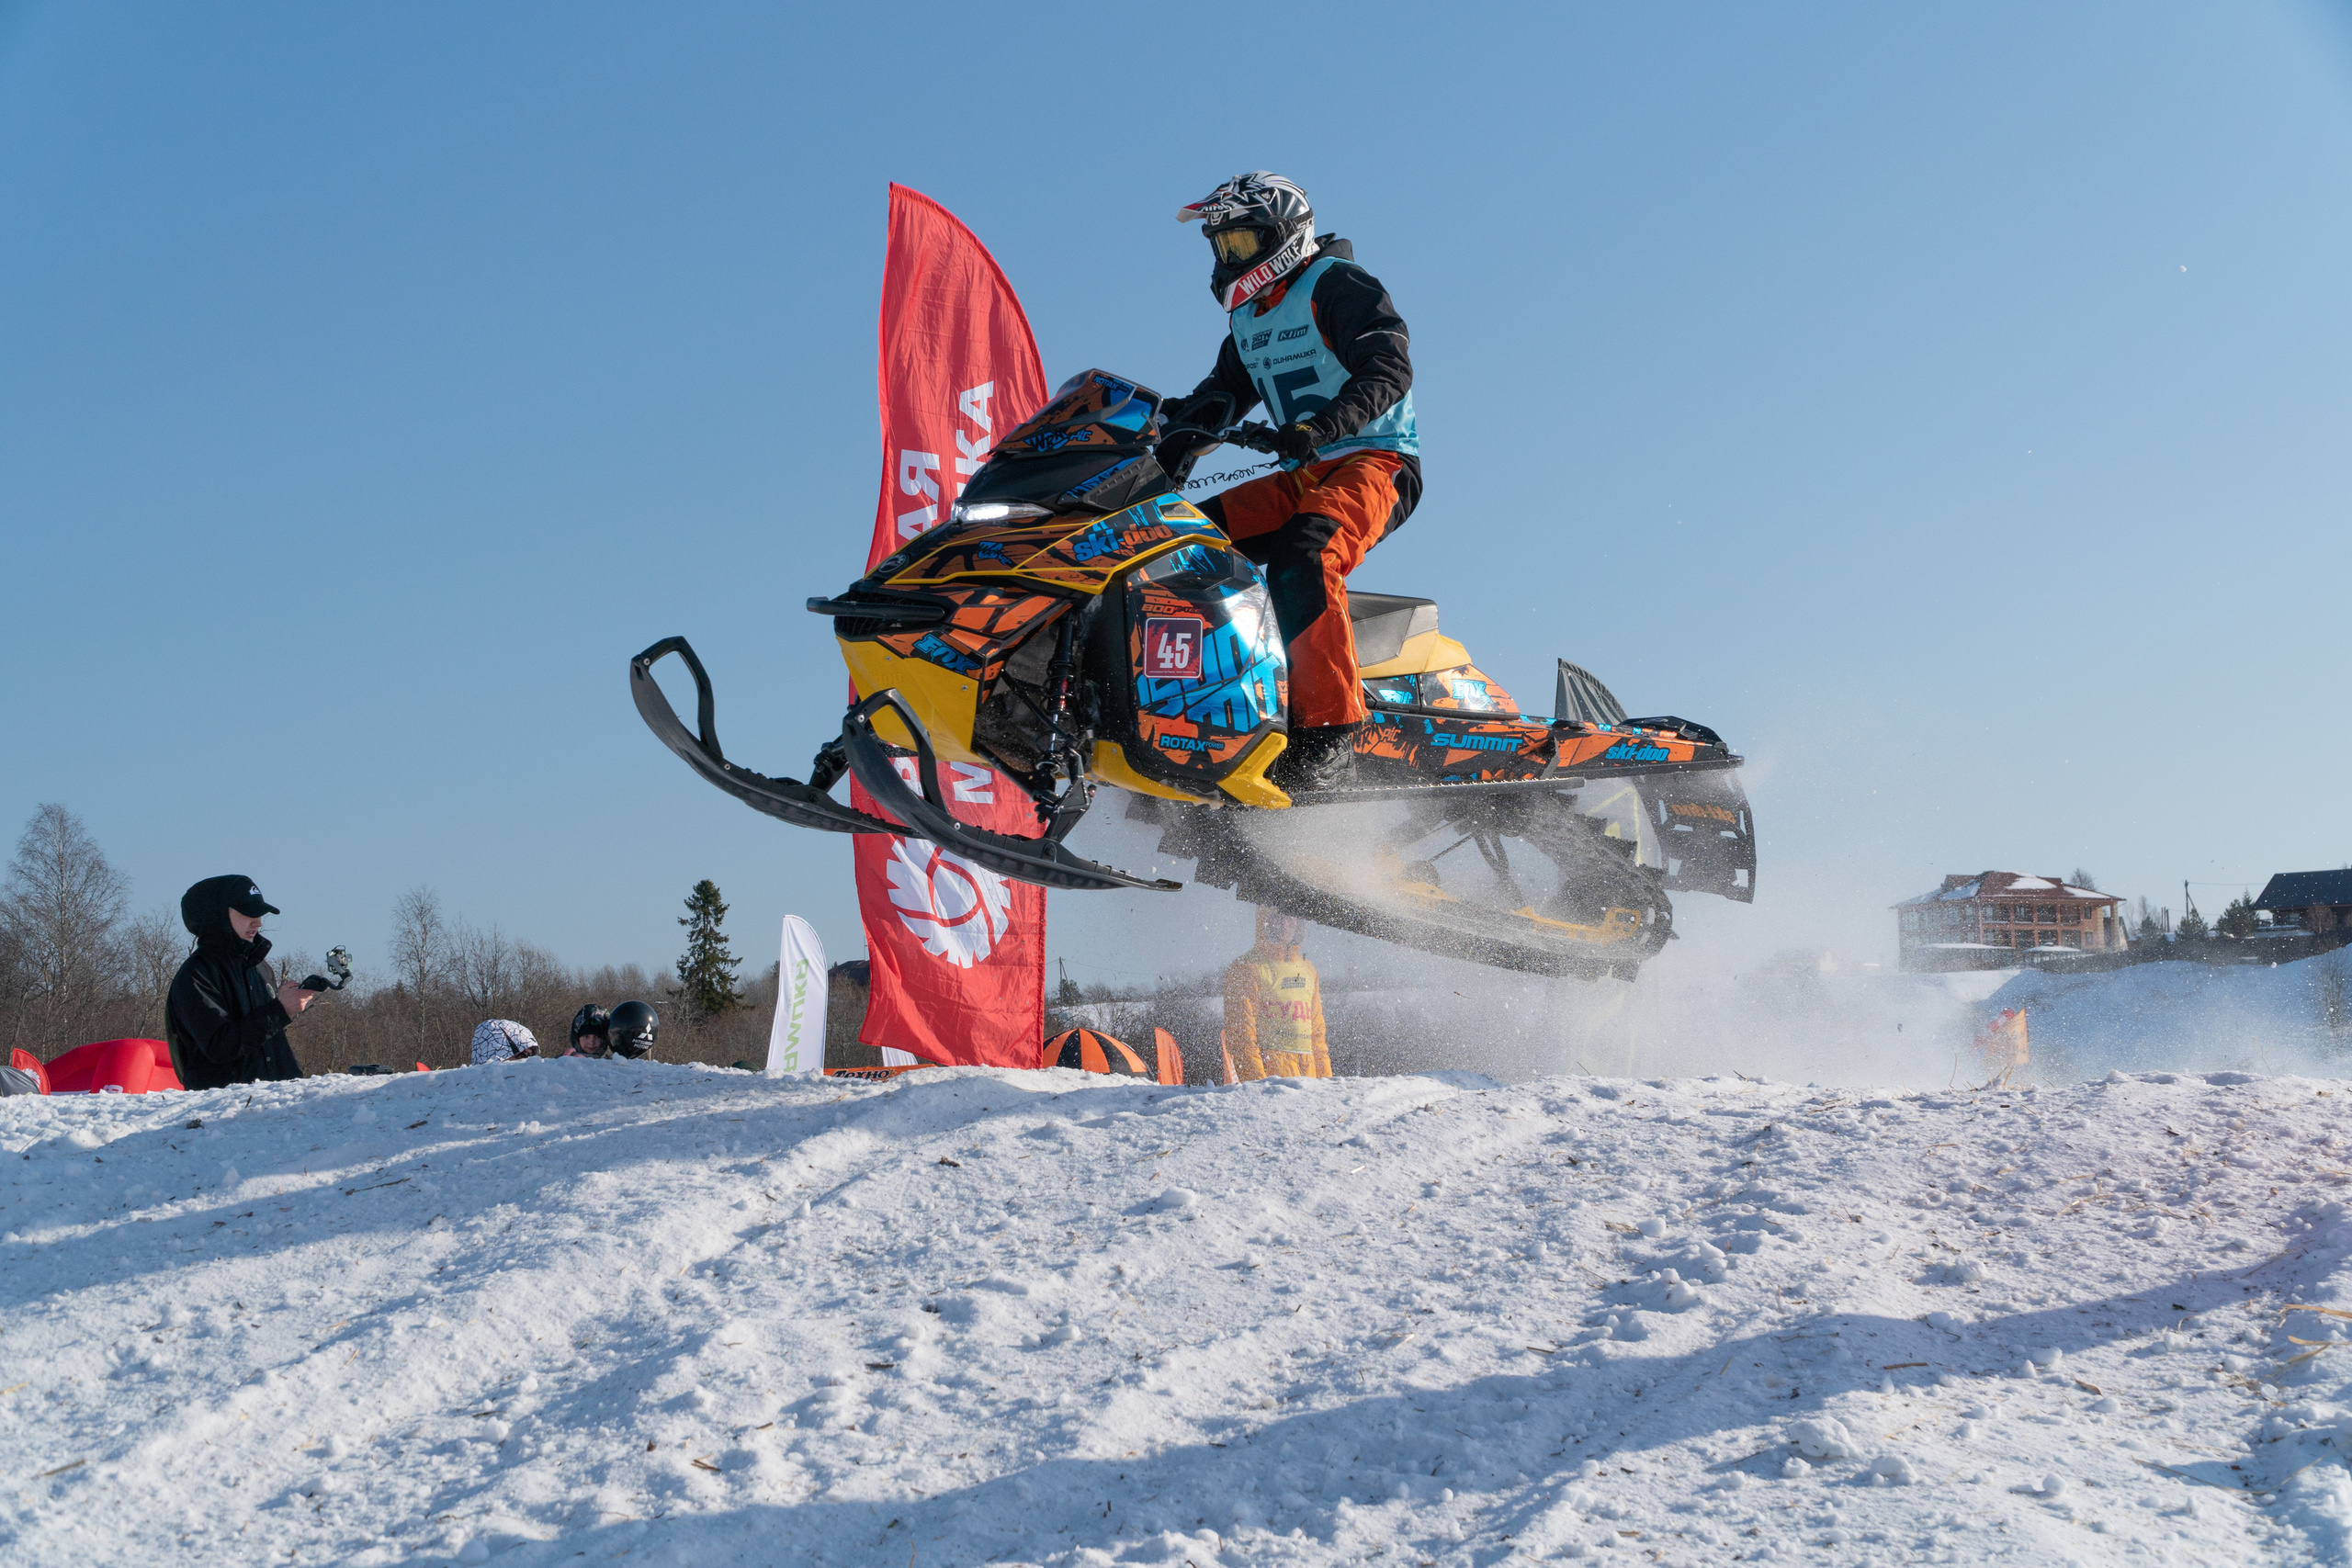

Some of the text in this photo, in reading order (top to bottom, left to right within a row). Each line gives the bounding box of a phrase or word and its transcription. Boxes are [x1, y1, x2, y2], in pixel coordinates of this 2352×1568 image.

[1238, 244, 1301, 295] WILD WOLF
[1072, 524, 1173, 562] ski-doo
[1141, 604, 1175, 614] 800
[913, 633, 980, 675] FOX
[1157, 633, 1192, 669] 45
[1452, 679, 1487, 700] FOX
[1160, 736, 1207, 751] ROTAX
[1430, 733, 1523, 752] SUMMIT
[1605, 743, 1670, 761] ski-doo
[1262, 1000, 1312, 1022] СУДЬ
